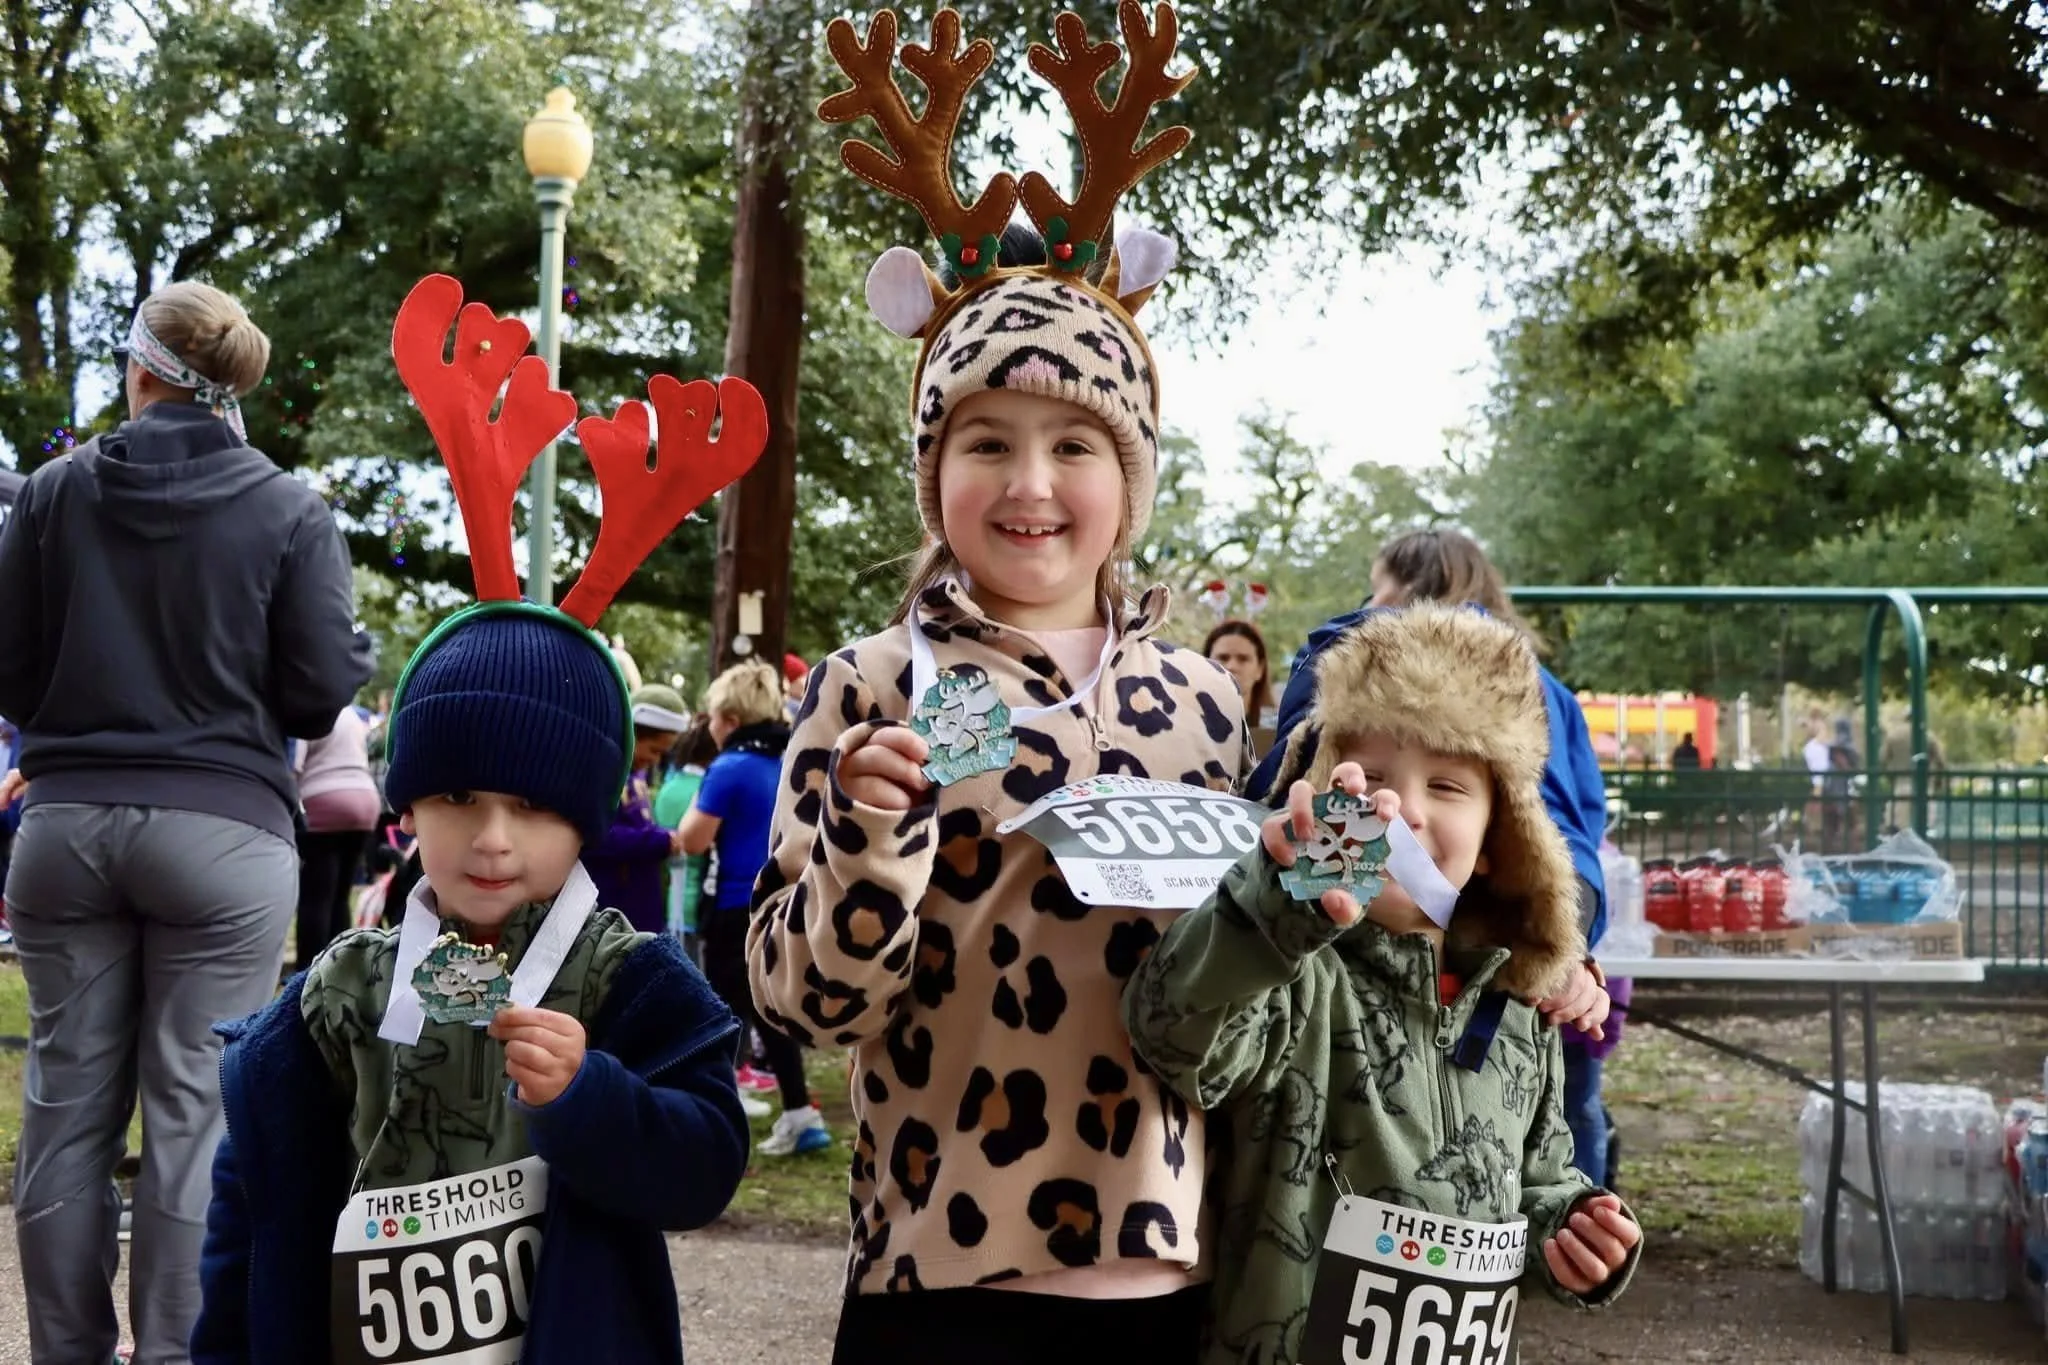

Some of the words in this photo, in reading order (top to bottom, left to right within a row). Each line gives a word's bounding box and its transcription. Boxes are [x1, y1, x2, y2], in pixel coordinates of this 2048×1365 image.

[1052, 799, 1261, 855] 5658
[1163, 876, 1194, 889] SCAN
[366, 1169, 523, 1216] THRESHOLD
[425, 1190, 524, 1231] TIMING
[1453, 1250, 1524, 1273] TIMING
[358, 1225, 543, 1358] 5660
[1342, 1269, 1519, 1365] 5659
